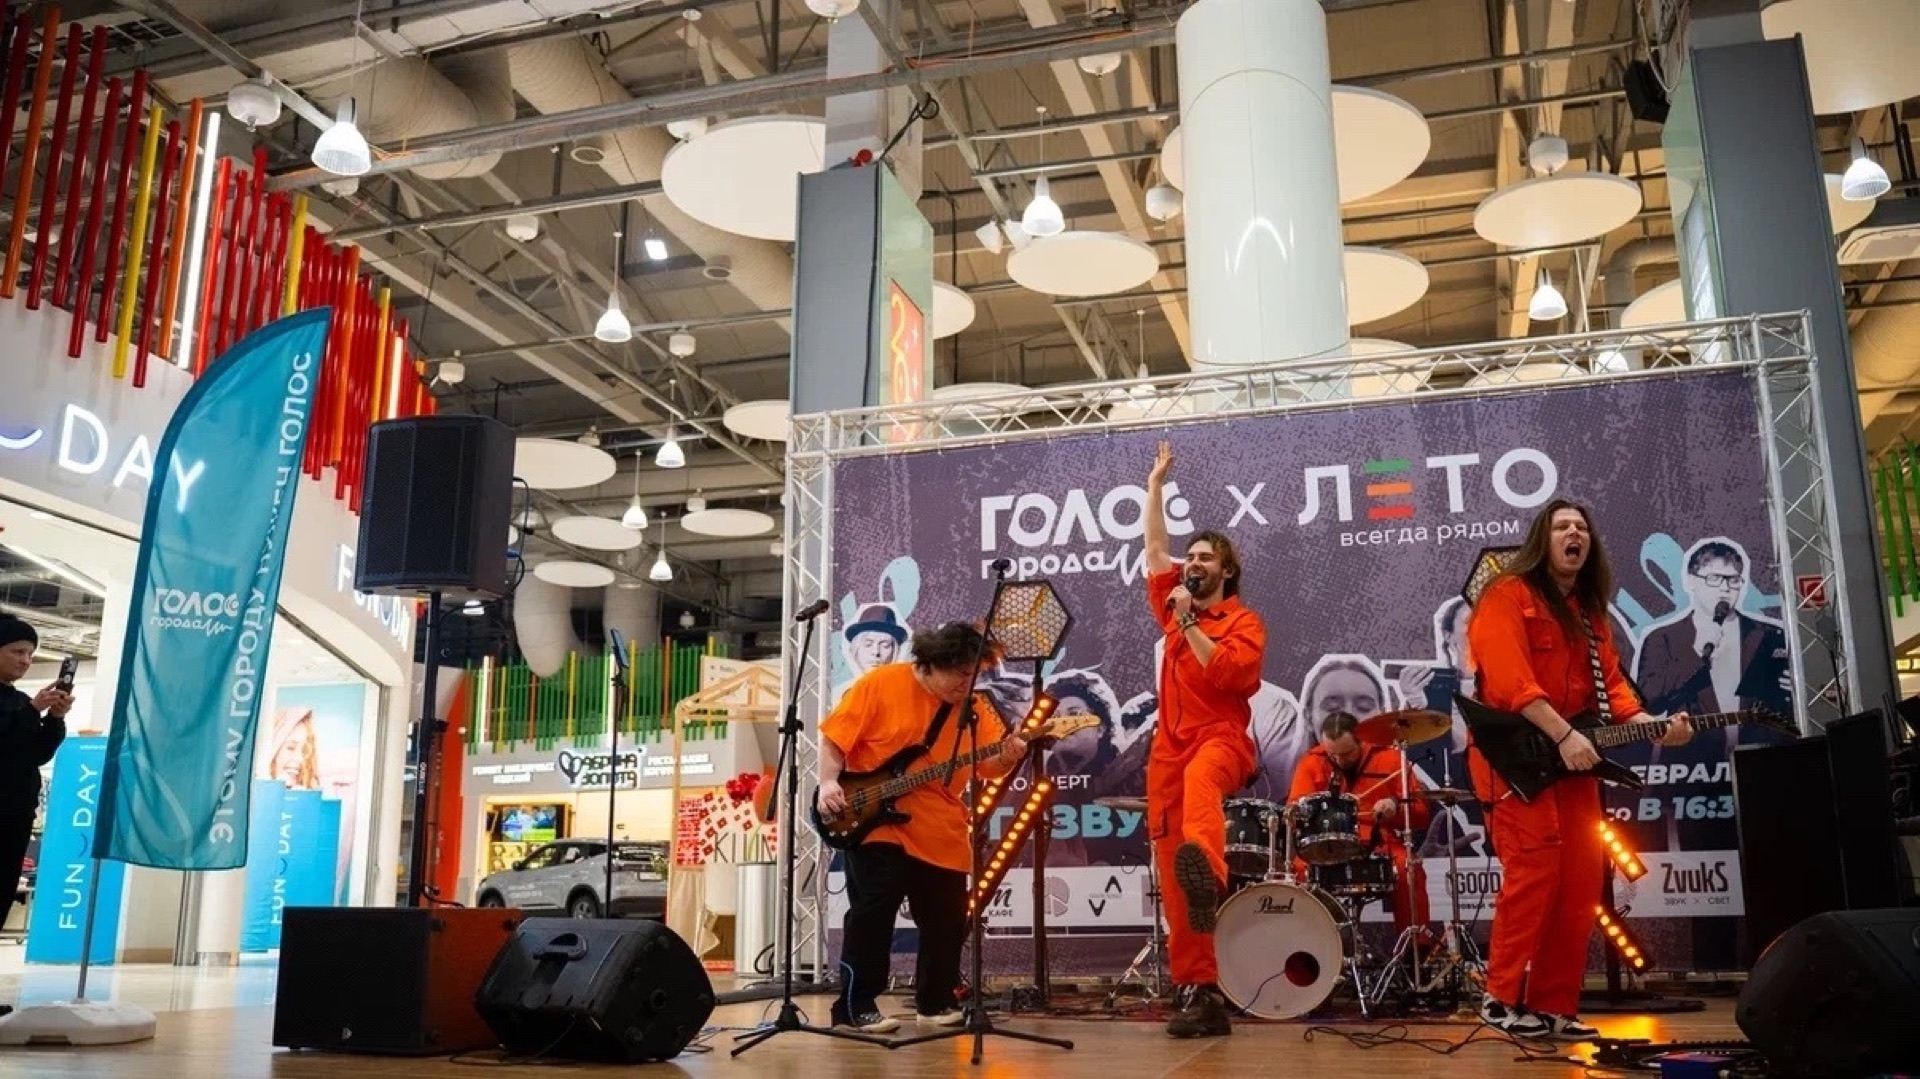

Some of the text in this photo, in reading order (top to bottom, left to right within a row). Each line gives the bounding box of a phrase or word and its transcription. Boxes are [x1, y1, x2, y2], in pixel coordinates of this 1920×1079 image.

[279, 352, 312, 455] ГОЛОС
[59, 403, 205, 514] DAY
[981, 481, 1195, 551] ГОЛОС
[1298, 448, 1558, 525] ЛЕТО
[1340, 519, 1520, 547] всегда рядом
[153, 588, 239, 616] ГОЛОС
[72, 763, 98, 827] DAY
[1637, 798, 1662, 821] В
[59, 863, 86, 929] FUN
[1661, 861, 1729, 893] ZvukS
